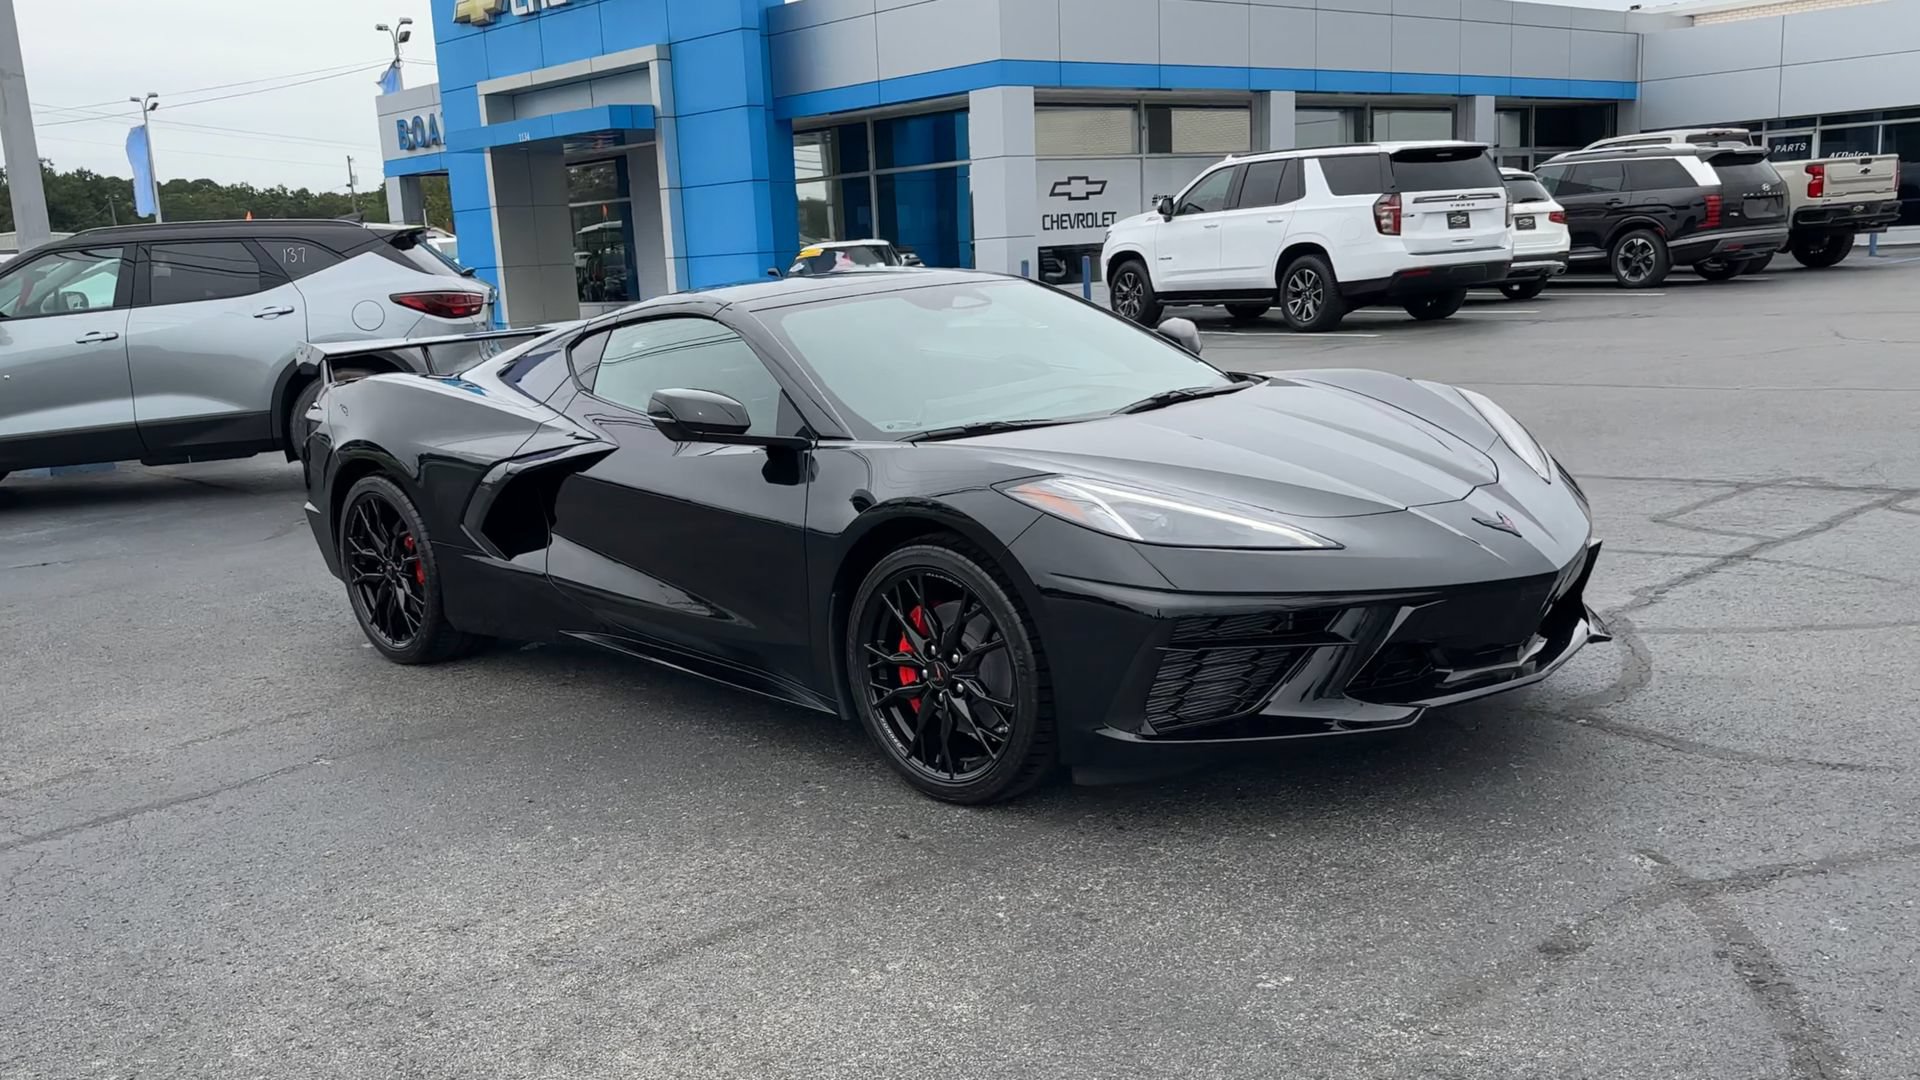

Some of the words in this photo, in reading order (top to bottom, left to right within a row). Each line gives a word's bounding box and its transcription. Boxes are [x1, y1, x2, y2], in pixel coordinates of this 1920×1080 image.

[396, 112, 446, 150] BOA
[1774, 142, 1807, 153] PARTS
[1042, 210, 1118, 231] CHEVROLET
[283, 247, 306, 264] 137
